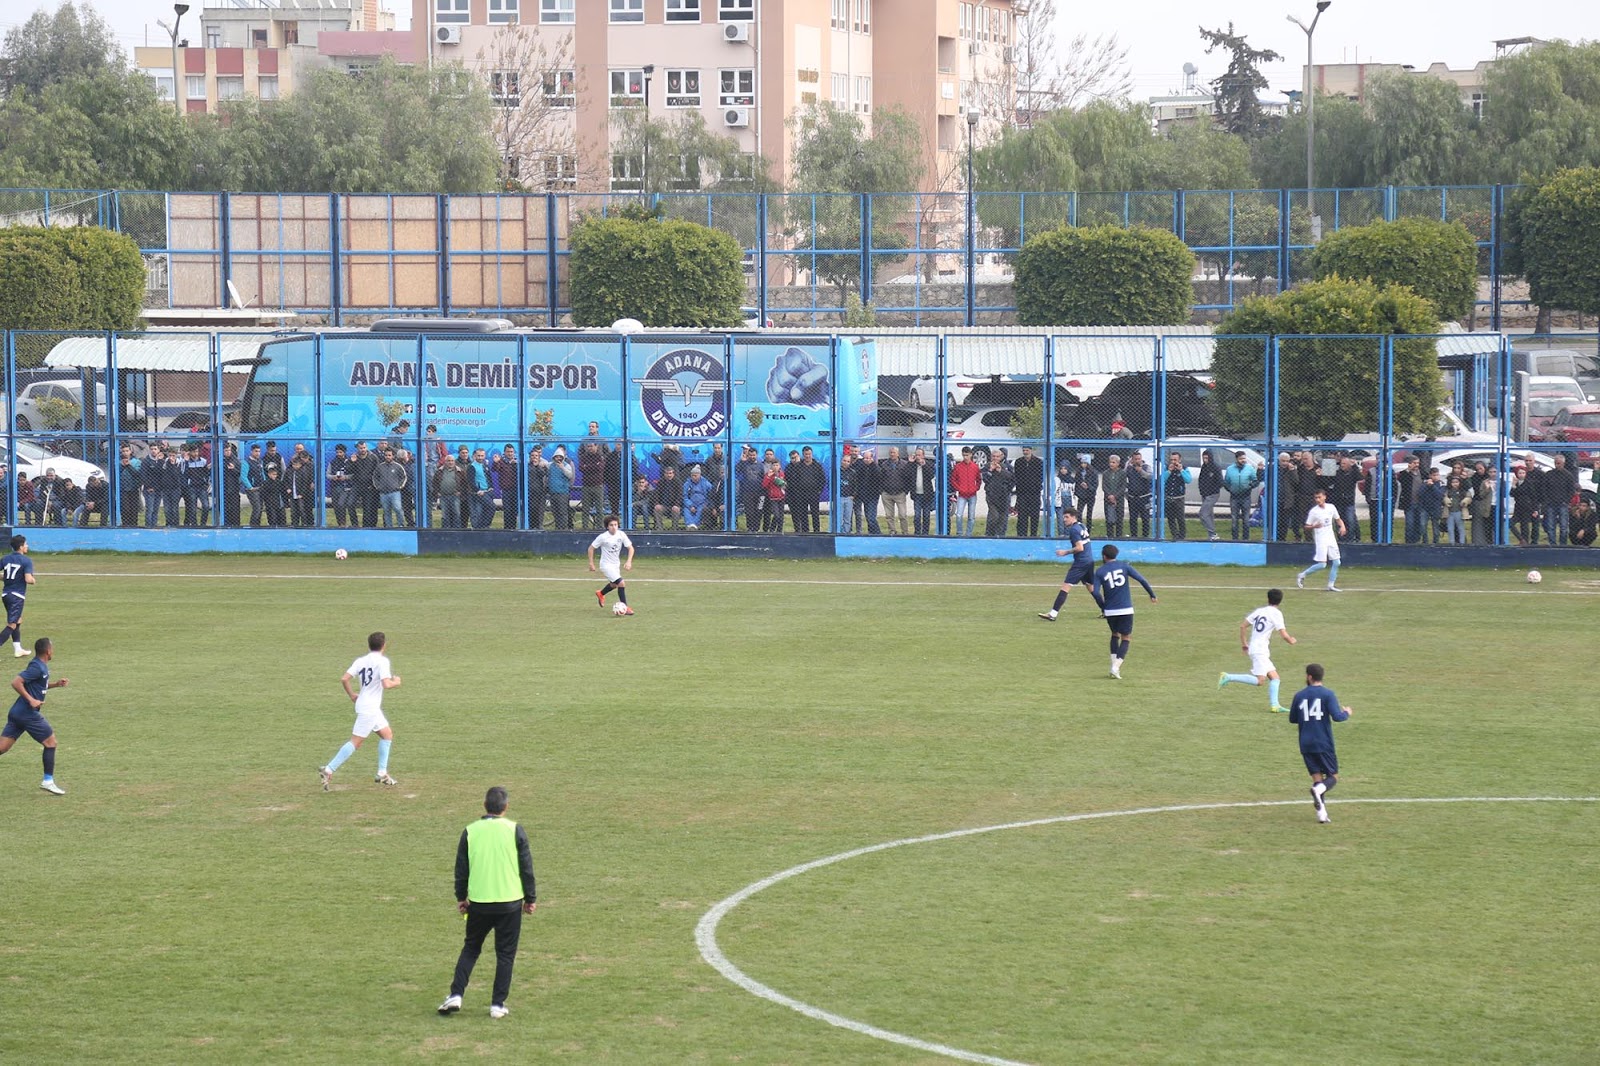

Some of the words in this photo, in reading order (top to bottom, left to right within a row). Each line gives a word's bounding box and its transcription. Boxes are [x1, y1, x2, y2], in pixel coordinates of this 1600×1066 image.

[664, 355, 712, 373] ADANA
[349, 361, 439, 387] ADANA
[651, 410, 725, 438] DEMİRSPOR
[4, 562, 21, 580] 17
[1104, 569, 1126, 589] 15
[1253, 615, 1267, 632] 16
[359, 667, 373, 686] 13
[1299, 698, 1324, 721] 14
